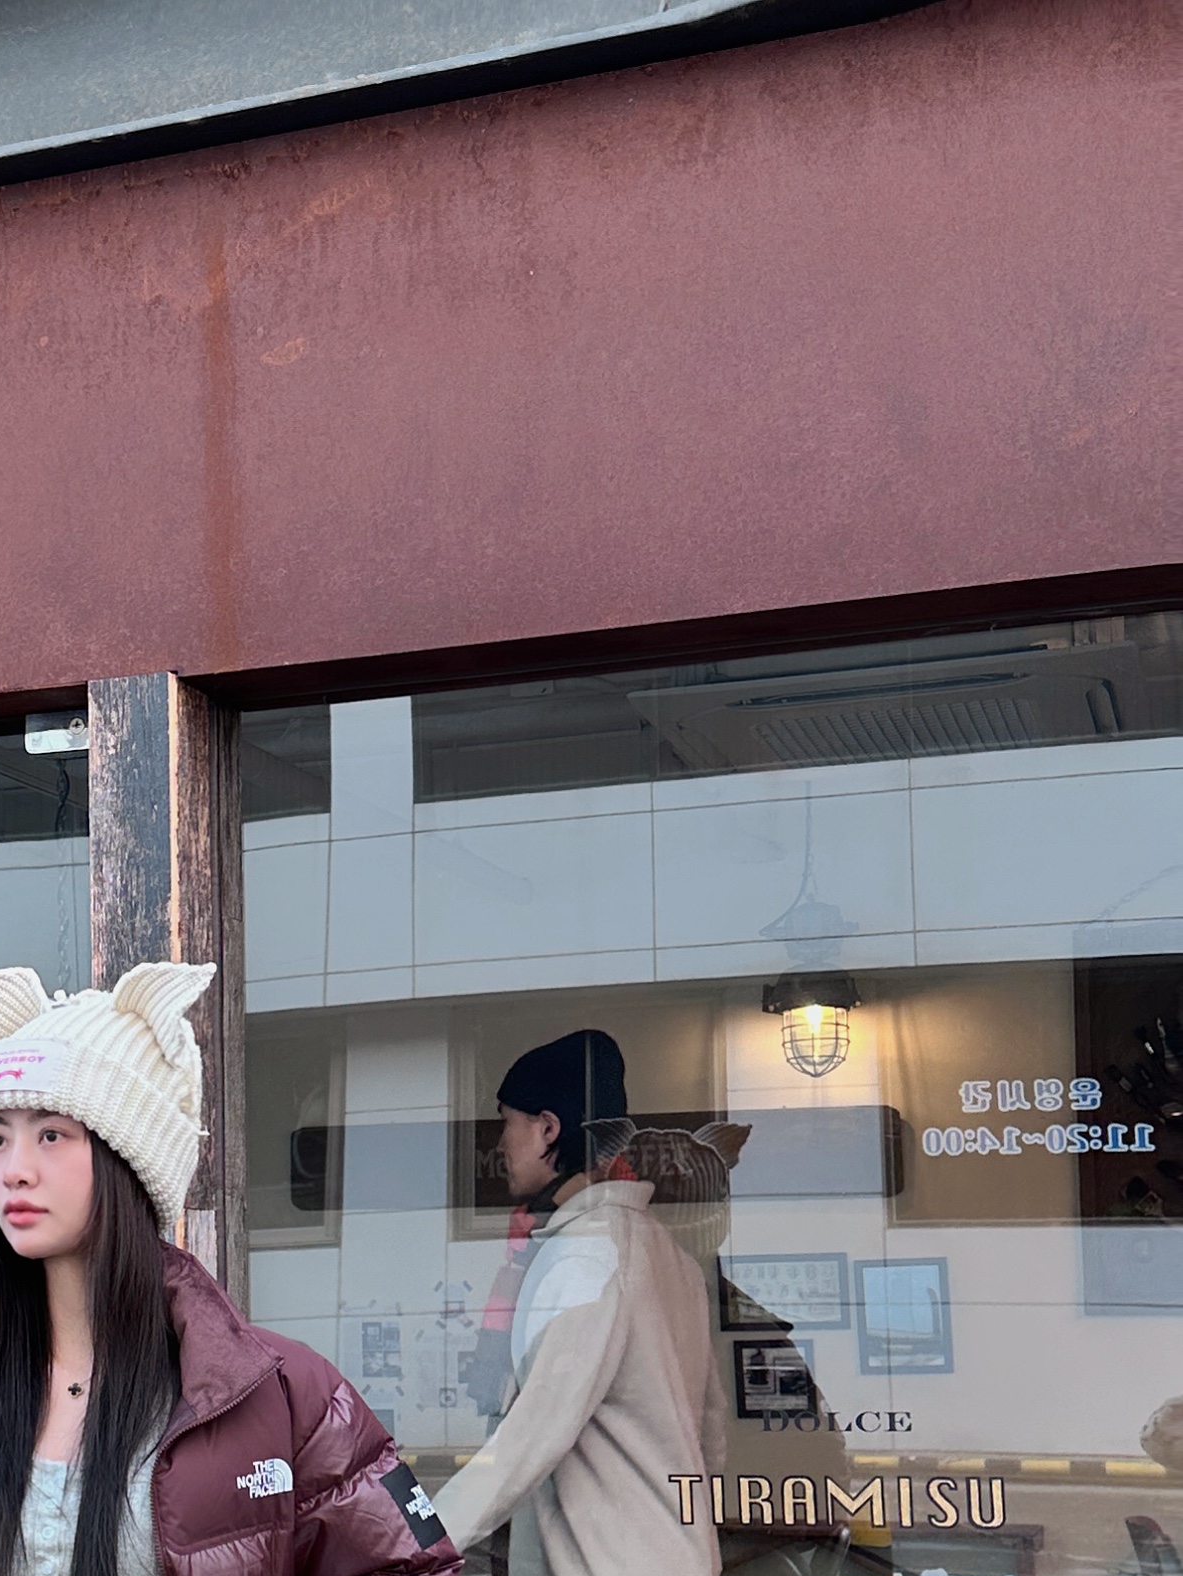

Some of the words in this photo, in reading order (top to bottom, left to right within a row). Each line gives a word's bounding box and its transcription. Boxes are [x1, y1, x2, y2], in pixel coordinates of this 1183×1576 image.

[760, 1410, 914, 1433] DOLCE
[252, 1460, 275, 1475] THE
[236, 1470, 275, 1490] NORTH
[249, 1482, 276, 1499] FACE
[668, 1474, 1007, 1530] TIRAMISU
